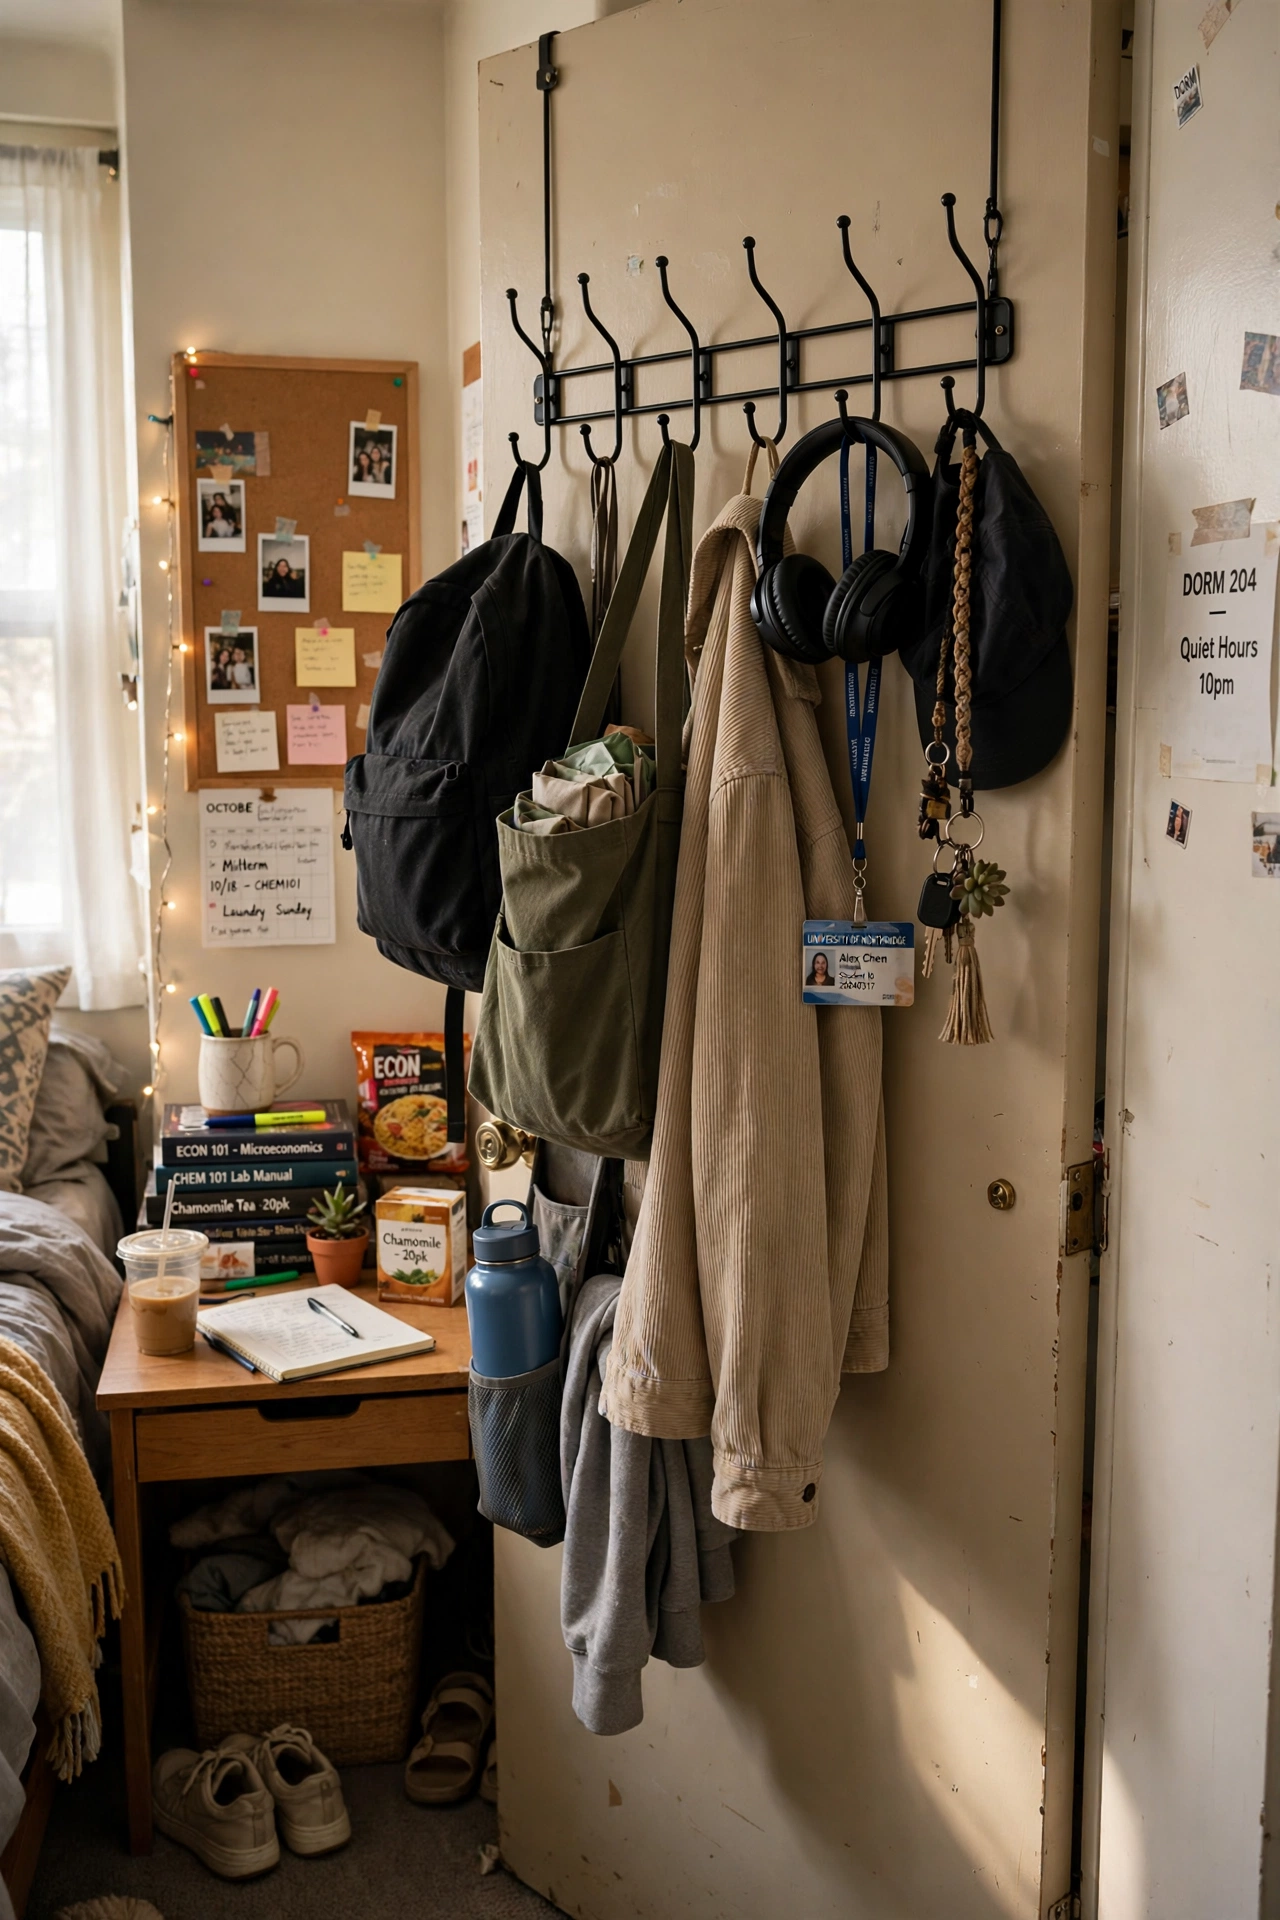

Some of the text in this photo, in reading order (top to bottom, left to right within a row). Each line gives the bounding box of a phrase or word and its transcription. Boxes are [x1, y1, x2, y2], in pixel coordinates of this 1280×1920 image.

[1183, 567, 1257, 597] DORM 204
[1180, 635, 1259, 663] Quiet Hours
[1199, 672, 1235, 701] 10pm
[206, 801, 254, 814] OCTOBE
[210, 877, 238, 896] 10/18
[254, 877, 301, 891] CHEM101
[223, 902, 312, 922] Laundry Sunday
[839, 952, 888, 963] Alex Chen
[373, 1054, 421, 1080] ECON
[176, 1144, 208, 1158] ECON
[211, 1143, 229, 1156] 101
[240, 1140, 324, 1156] Microeconomics
[173, 1167, 293, 1185] CHEM 101 Lab Manual
[170, 1198, 234, 1215] Chamomile
[236, 1198, 257, 1212] Tea
[382, 1232, 442, 1249] Chamomile
[402, 1248, 429, 1265] 20pk
